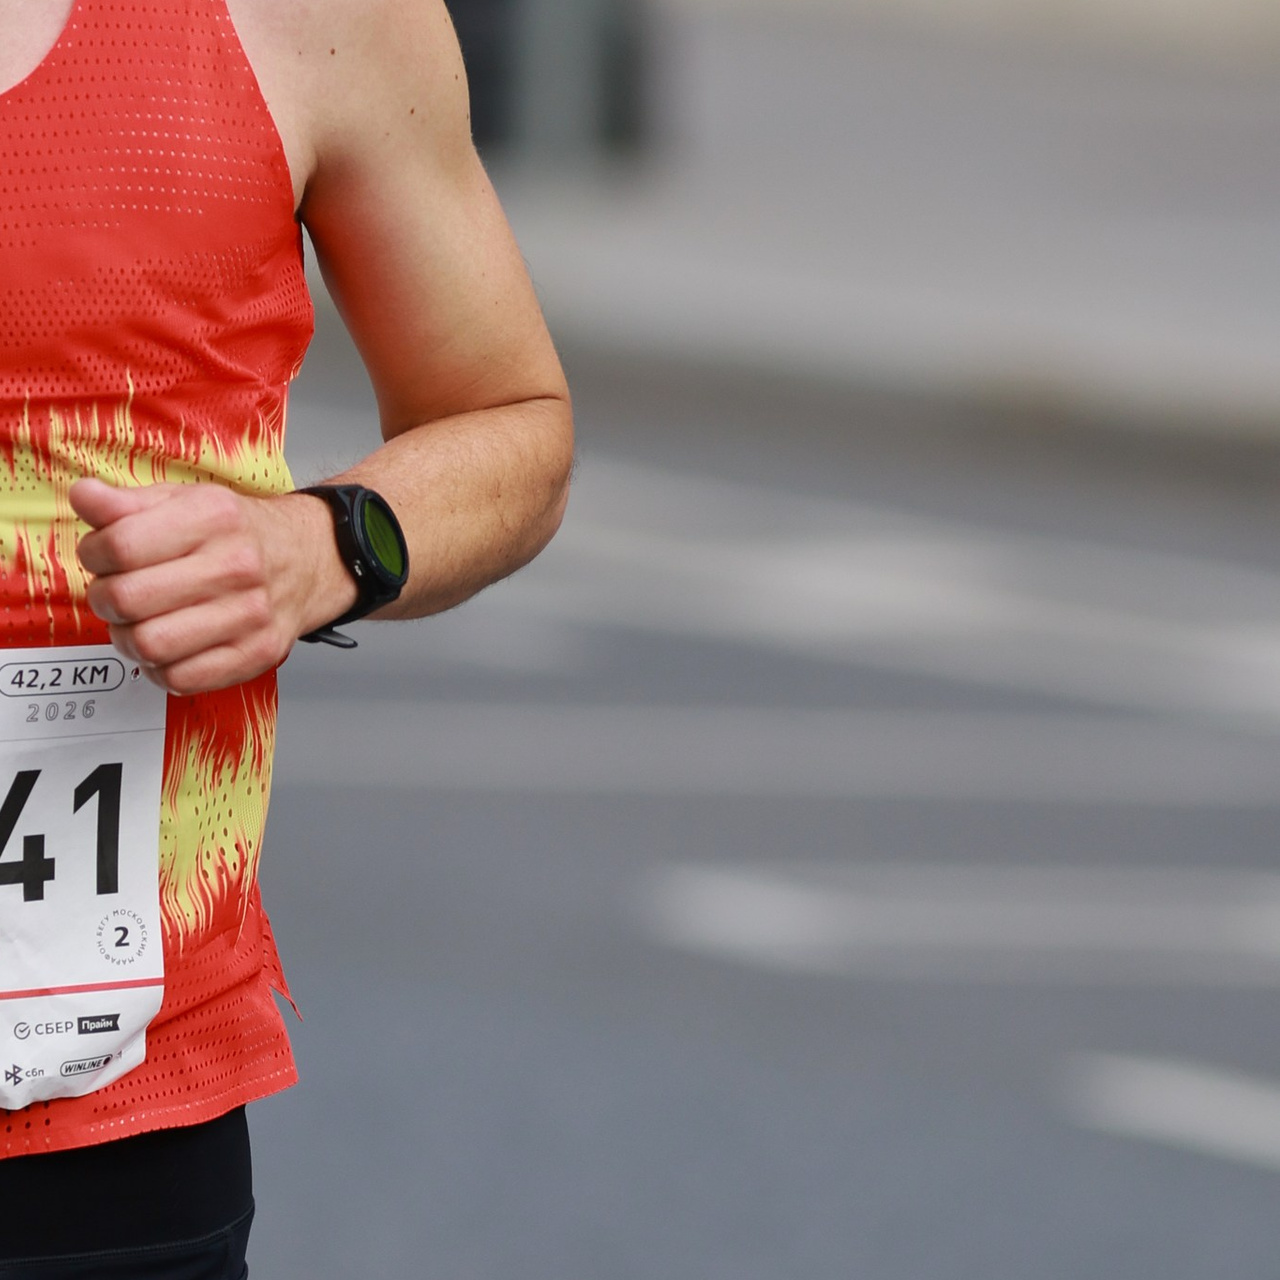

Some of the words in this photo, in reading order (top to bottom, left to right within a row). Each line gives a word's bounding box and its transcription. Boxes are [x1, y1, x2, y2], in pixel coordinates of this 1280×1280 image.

[10, 668, 63, 690] 42,2
[72, 665, 110, 685] КМ
[26, 699, 96, 722] 2026
[114, 926, 130, 948] 2
[34, 1021, 74, 1036] СБЕР
[81, 1018, 114, 1031] Прайм
[64, 1059, 104, 1074] WINLINE
